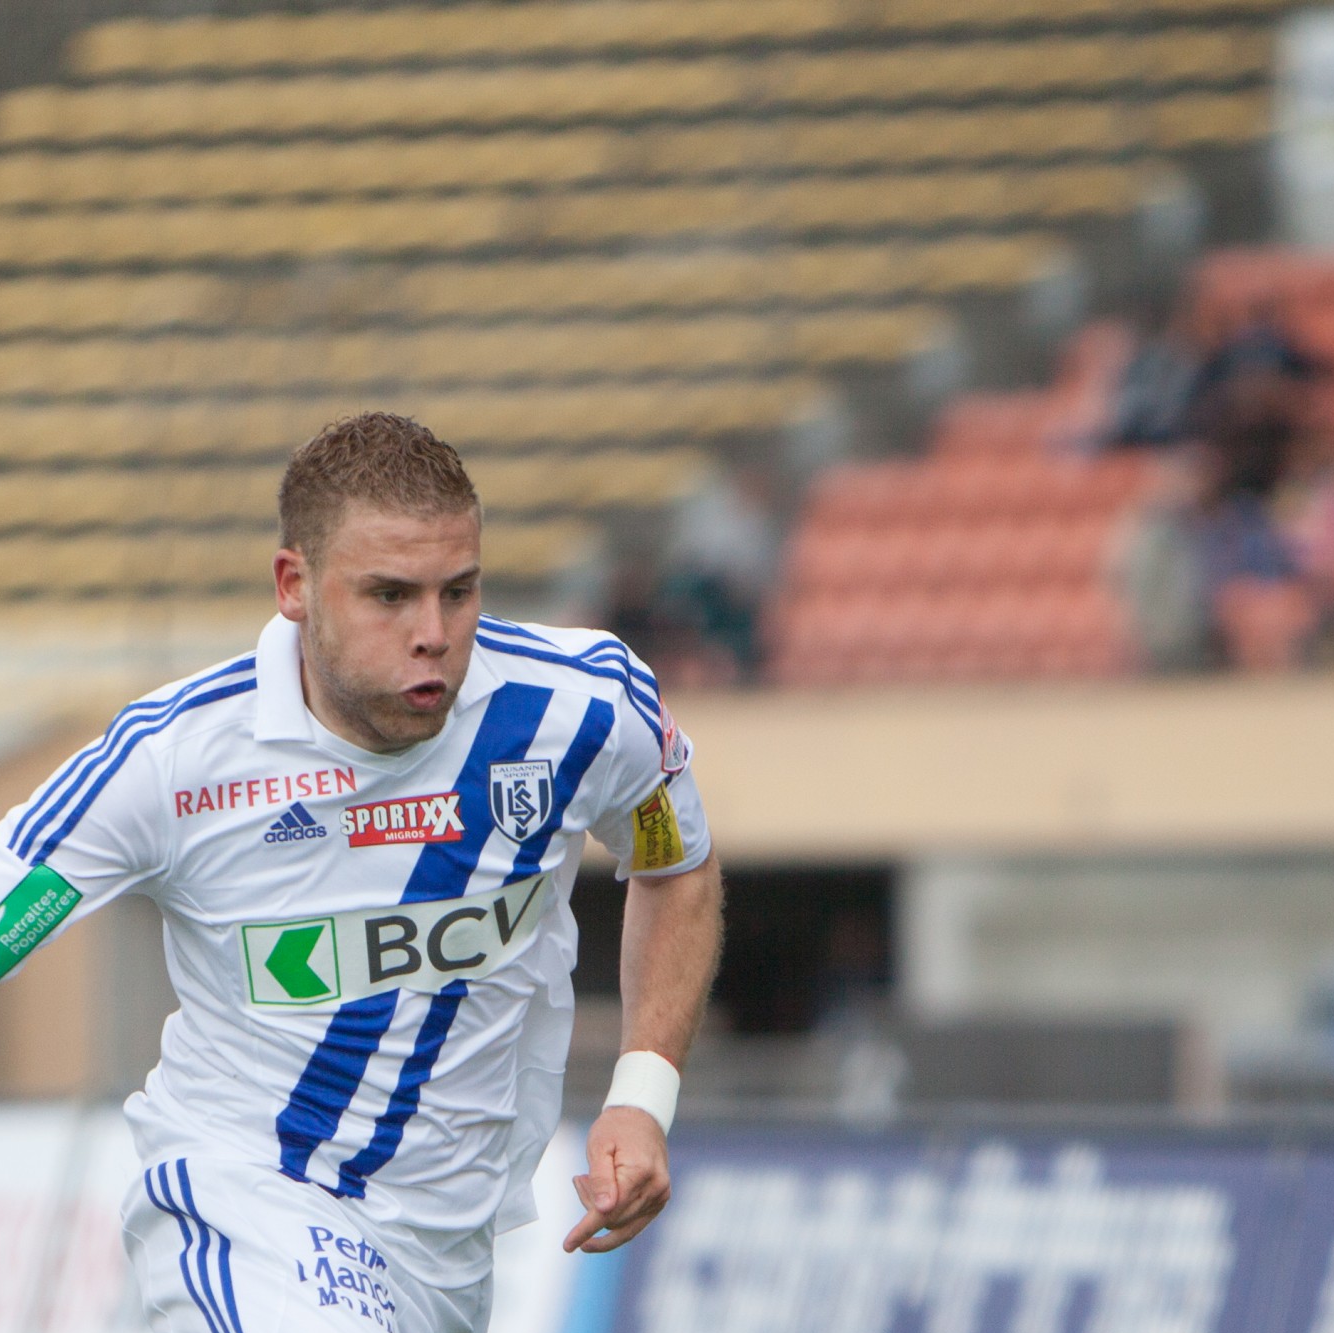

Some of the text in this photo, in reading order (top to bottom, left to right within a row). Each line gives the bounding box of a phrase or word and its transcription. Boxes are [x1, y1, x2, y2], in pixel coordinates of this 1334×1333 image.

[175, 767, 358, 818] RAIFFEISEN
[493, 765, 546, 773] LAUSANNE
[264, 825, 327, 843] adidas
[385, 829, 426, 841] MIGROS
[0, 888, 57, 947] Retraites
[10, 887, 76, 955] Populaires
[365, 877, 545, 984] BCV
